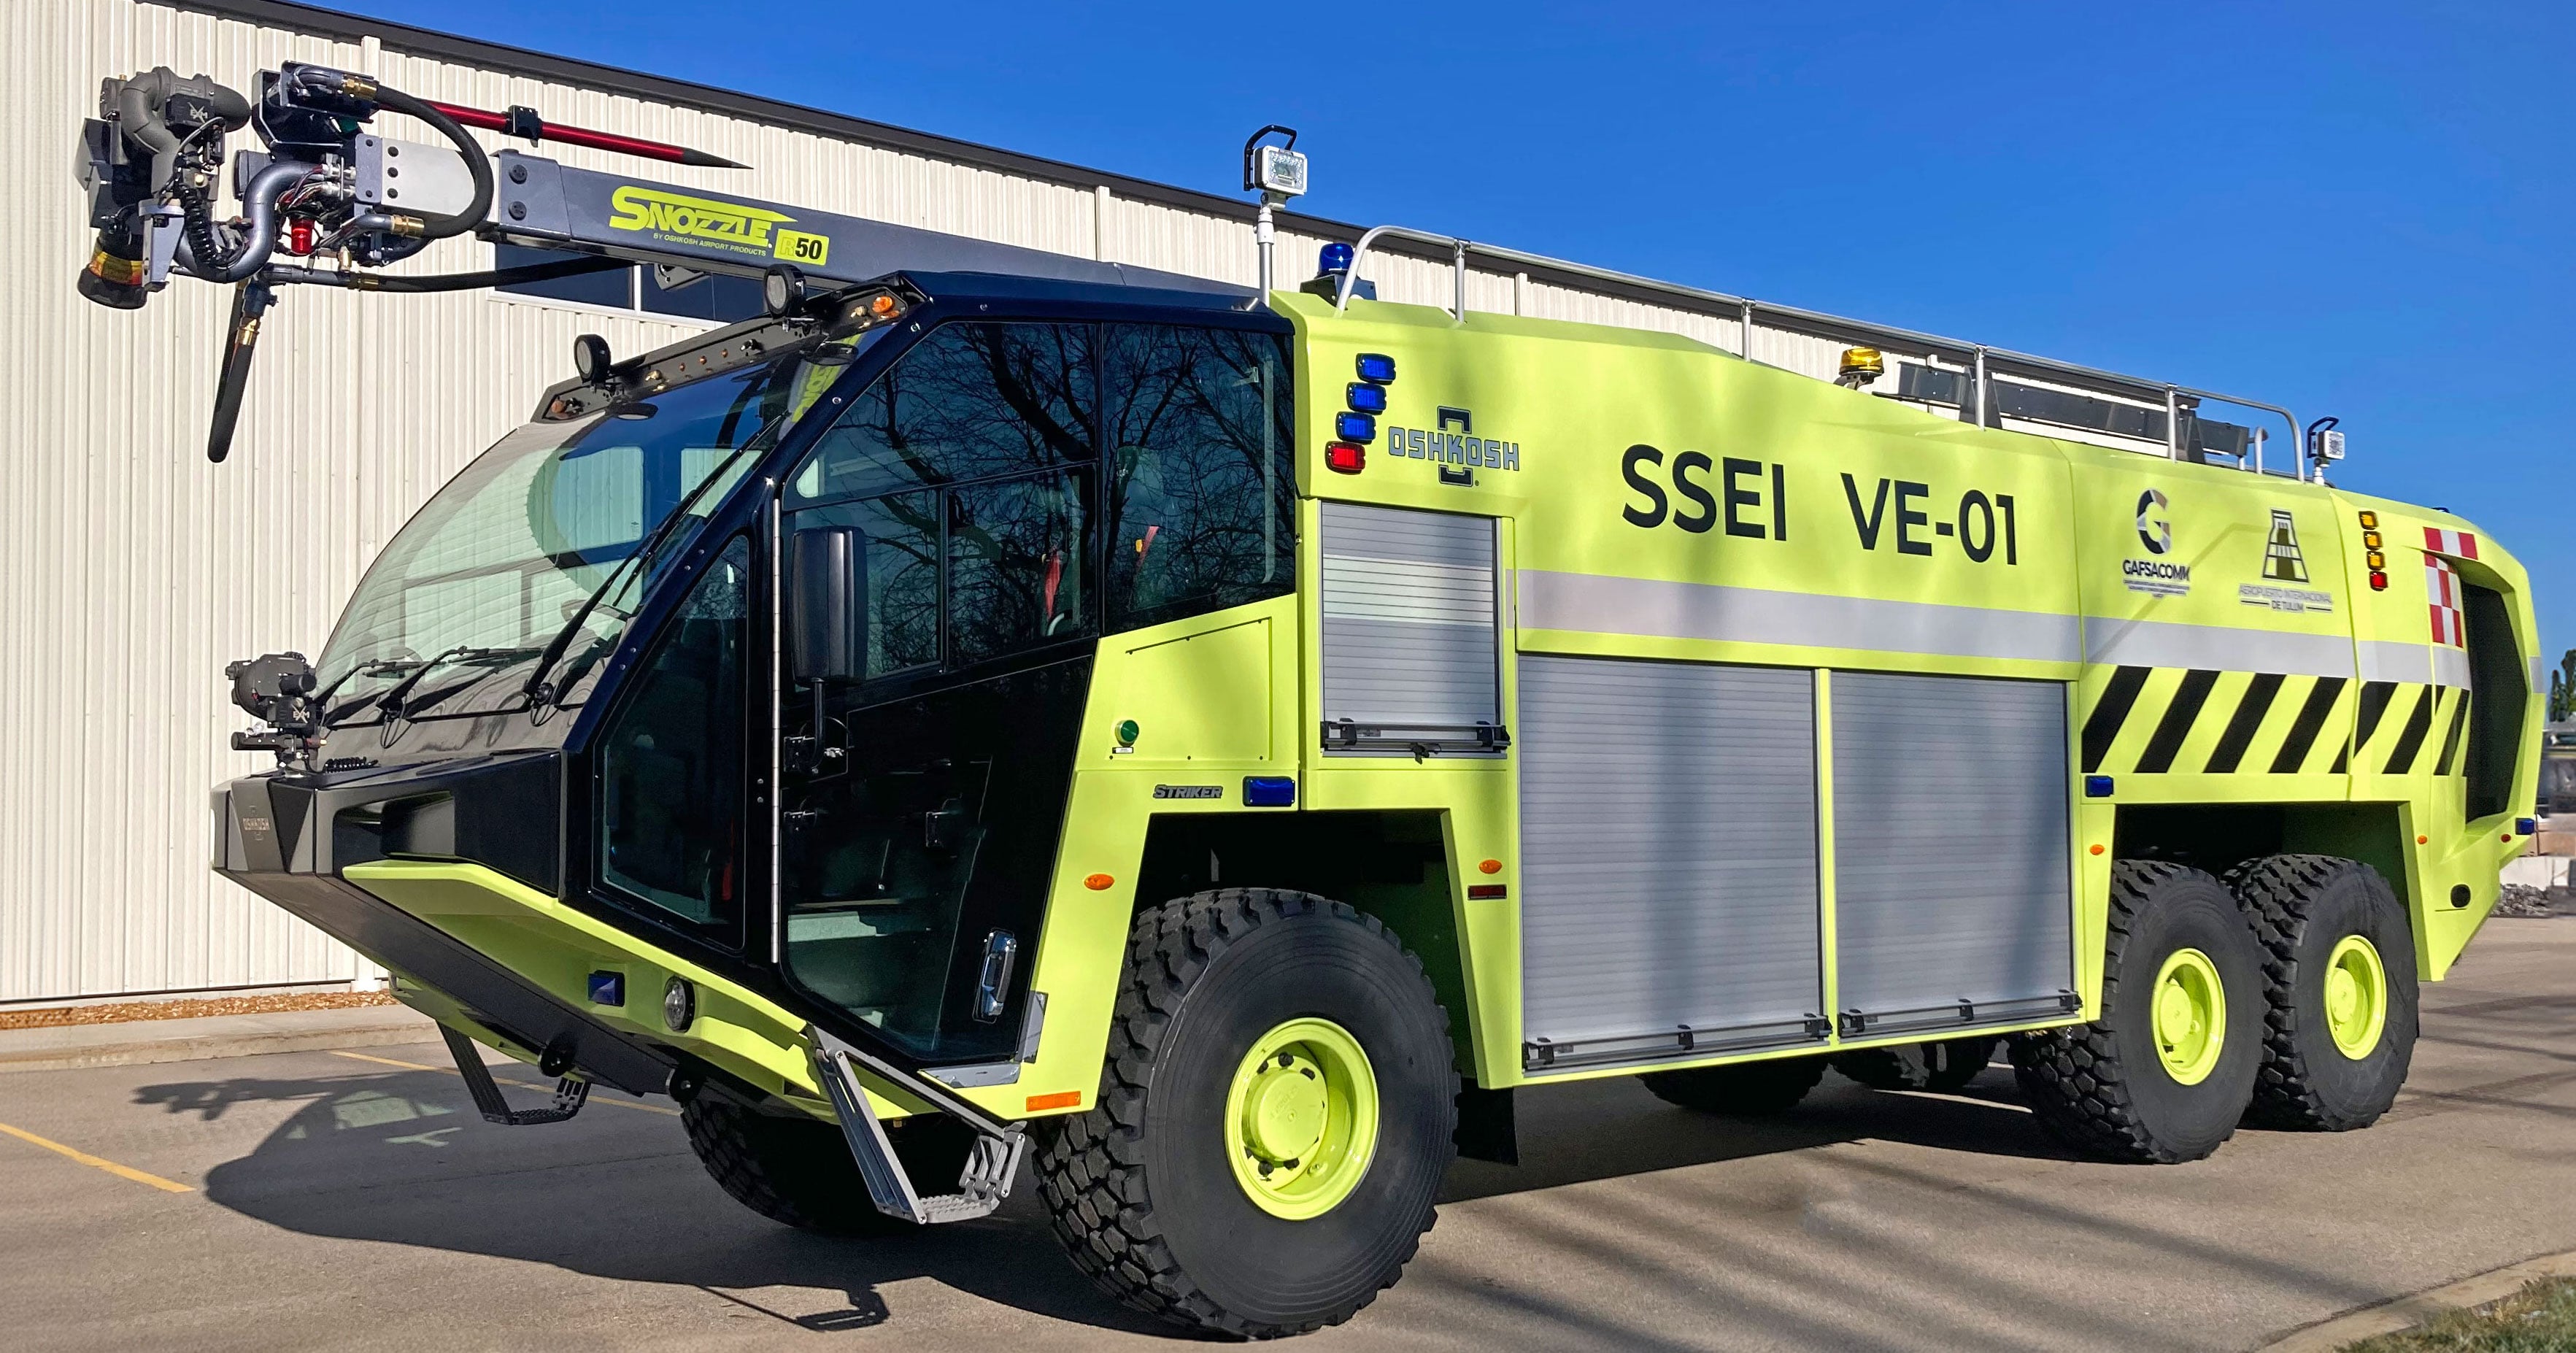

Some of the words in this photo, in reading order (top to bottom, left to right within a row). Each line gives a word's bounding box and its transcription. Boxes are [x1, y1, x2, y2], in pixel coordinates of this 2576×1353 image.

[609, 185, 798, 247] SNOZZLE
[653, 232, 663, 240] BY
[664, 234, 698, 246] OSHKOSH
[699, 240, 729, 251] AIRPORT
[730, 244, 767, 257] PRODUCTS
[1388, 426, 1520, 471] OSHKOSH
[1621, 444, 1787, 541] SSEI
[1840, 472, 2017, 566] VE-01
[2271, 601, 2282, 610] DE
[1153, 785, 1223, 799] STRIKER
